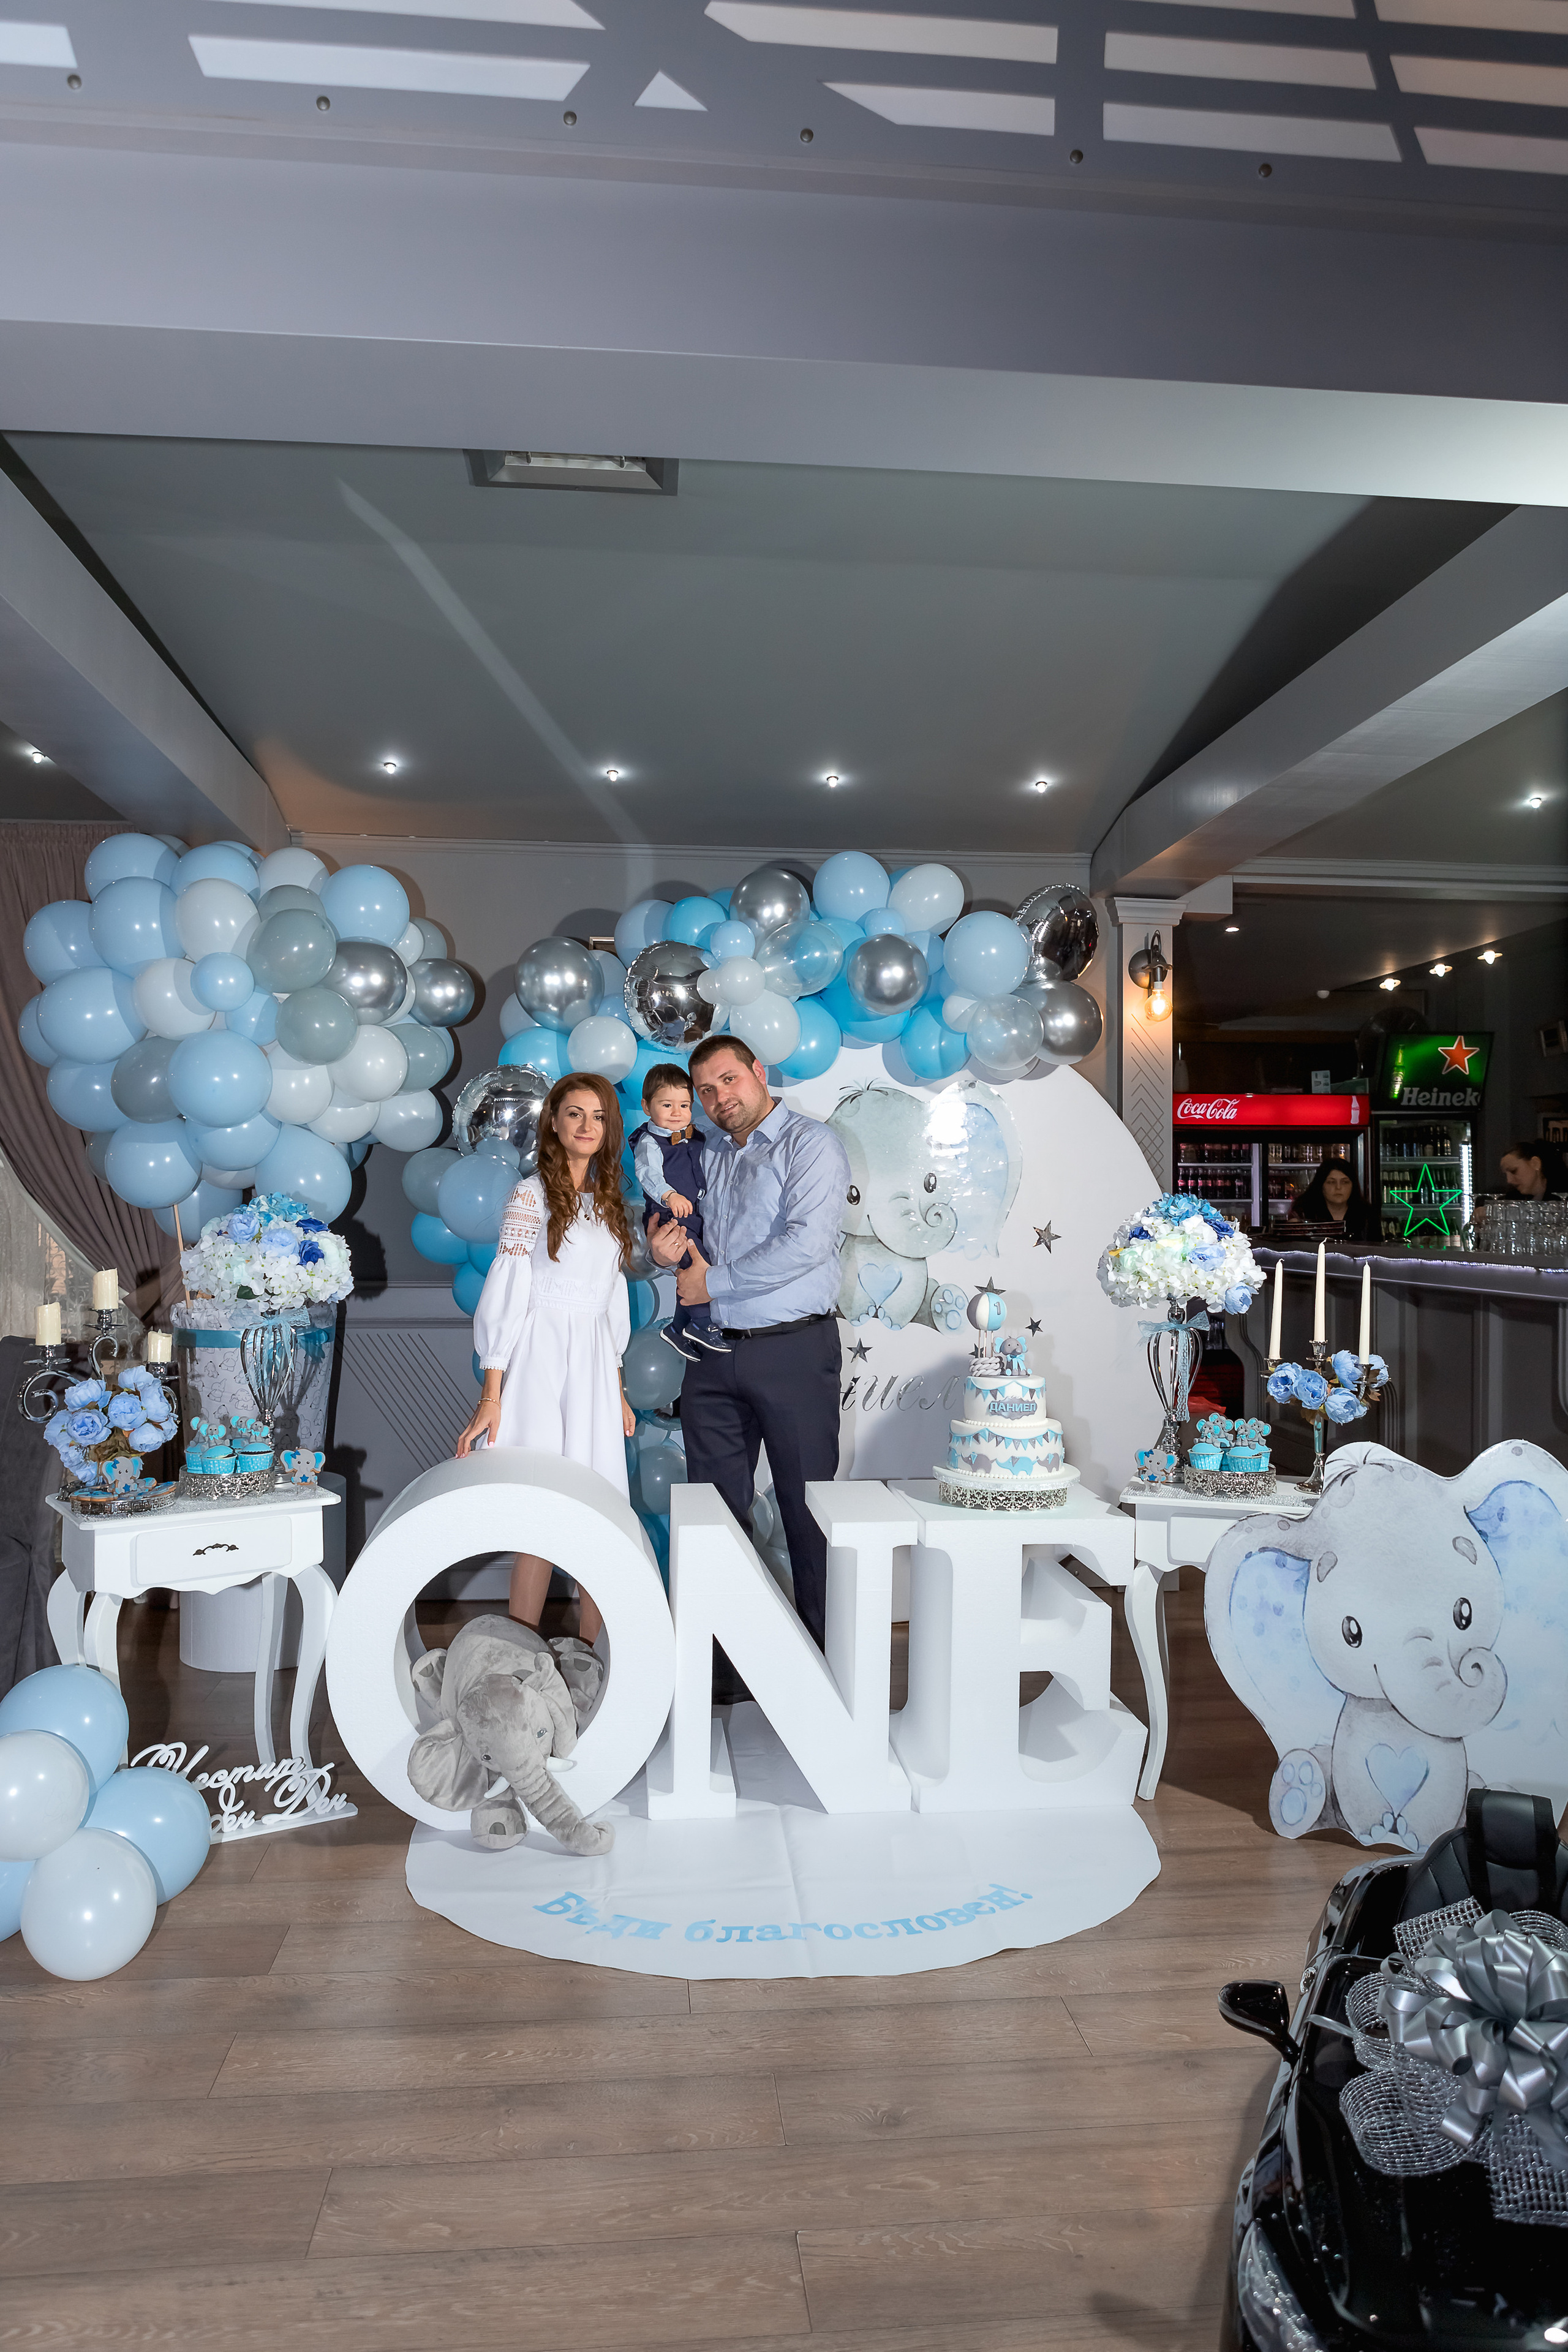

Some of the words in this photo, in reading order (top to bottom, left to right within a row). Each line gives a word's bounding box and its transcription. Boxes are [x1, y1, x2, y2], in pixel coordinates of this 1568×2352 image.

[1401, 1087, 1481, 1107] Heinek
[1177, 1098, 1240, 1120] Coca-Cola
[993, 1302, 1002, 1316] 1
[989, 1401, 1037, 1414] ДАНИЕЛ
[325, 1446, 1147, 1832] ONE
[684, 1883, 1033, 1943] благословен!
